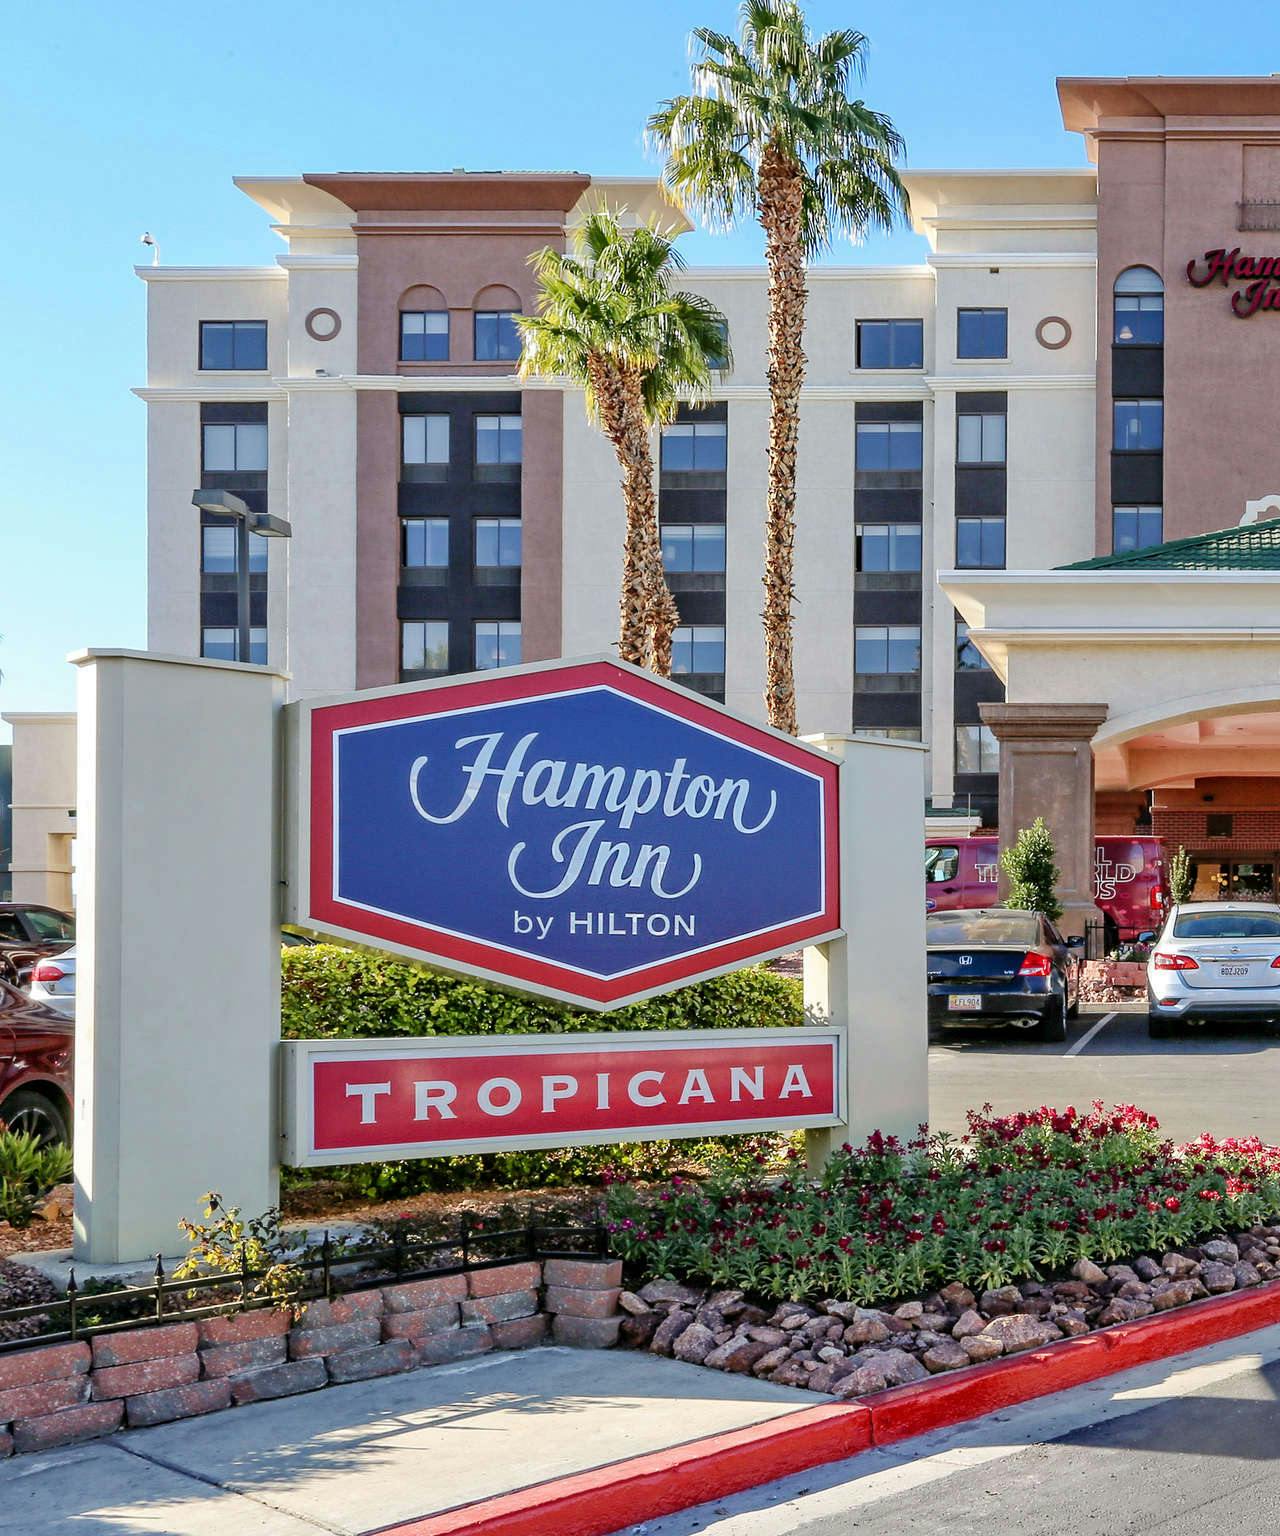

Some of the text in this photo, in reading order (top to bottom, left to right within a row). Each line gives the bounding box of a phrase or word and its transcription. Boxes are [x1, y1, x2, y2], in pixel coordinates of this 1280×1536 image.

[409, 732, 776, 835] Hampton
[507, 819, 702, 899] Inn
[514, 911, 696, 939] by HILTON
[345, 1064, 814, 1124] TROPICANA
